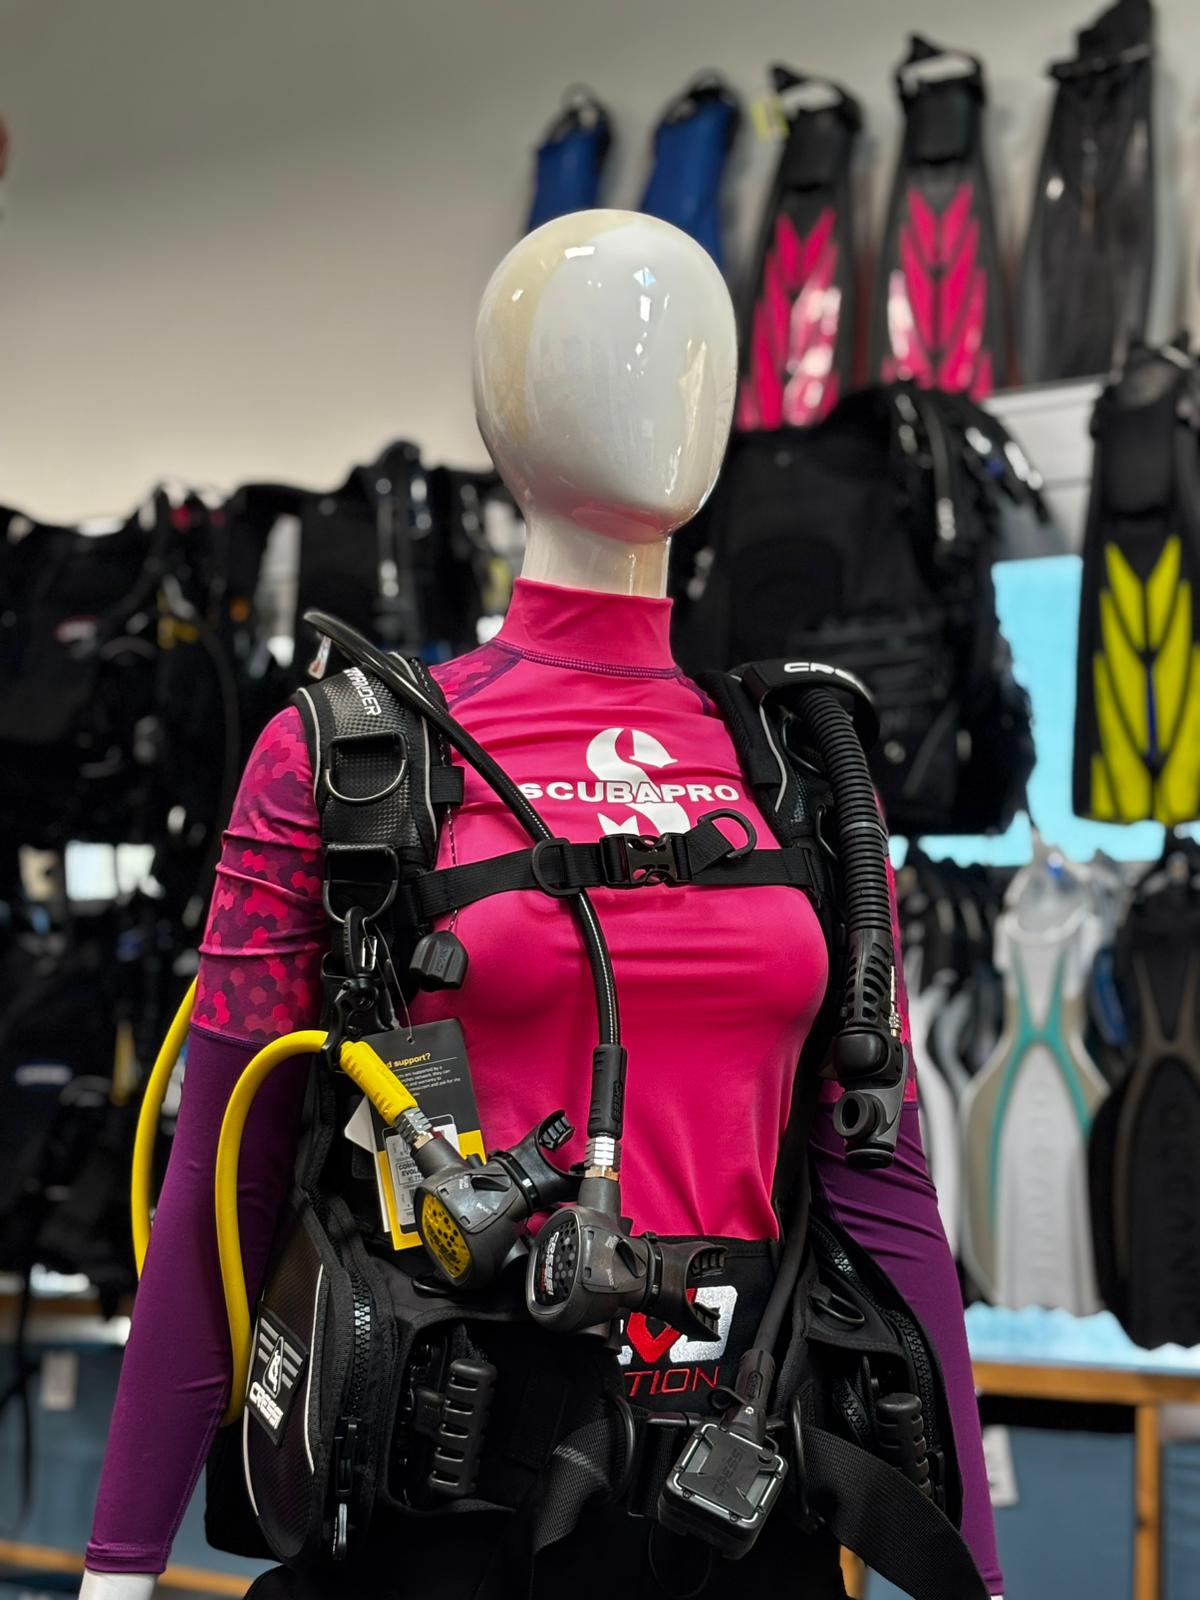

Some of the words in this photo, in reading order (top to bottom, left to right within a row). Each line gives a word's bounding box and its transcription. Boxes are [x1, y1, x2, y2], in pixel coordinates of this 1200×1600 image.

[518, 781, 740, 804] SCUBAPRO
[393, 1052, 431, 1067] support?
[624, 1366, 720, 1397] TION
